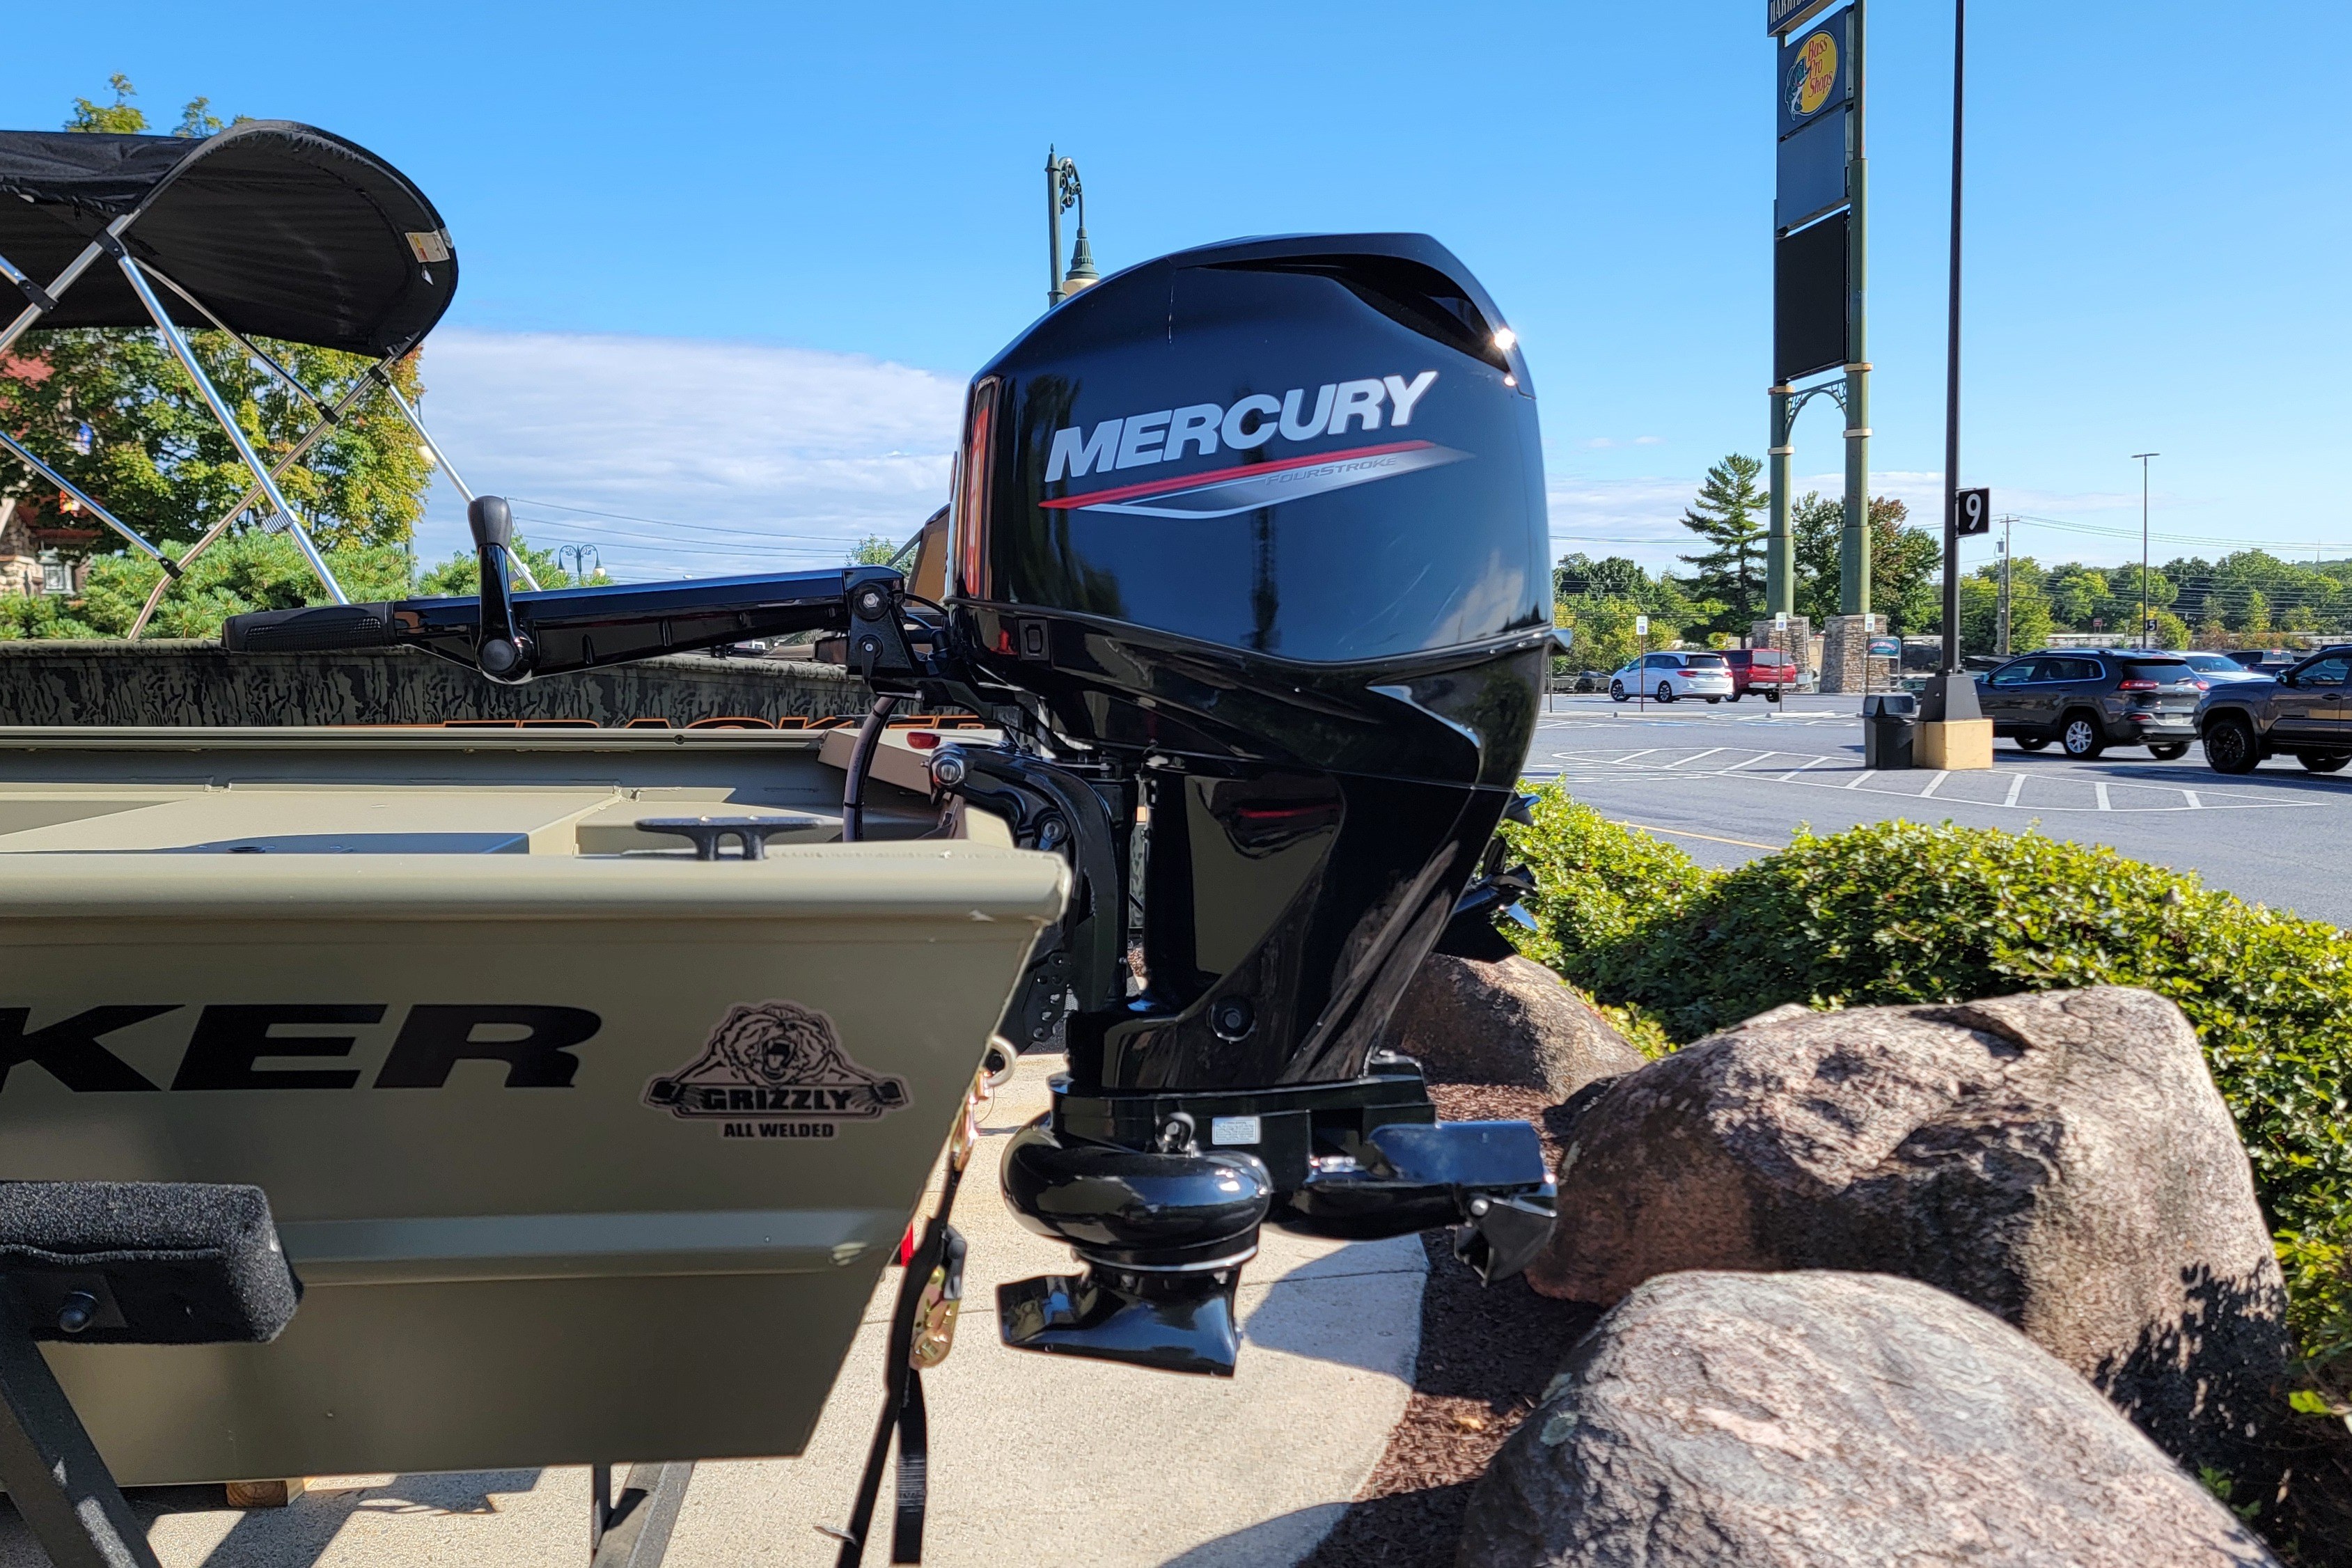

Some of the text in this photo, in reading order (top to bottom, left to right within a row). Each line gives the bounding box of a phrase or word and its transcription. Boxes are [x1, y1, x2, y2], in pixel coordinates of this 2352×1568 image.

[1808, 37, 1828, 62] Bass
[1810, 59, 1823, 79] Pro
[1808, 71, 1833, 97] Shops
[1044, 370, 1438, 483] MERCURY
[1265, 456, 1397, 485] FOURSTROKE
[1966, 493, 1982, 531] 9
[0, 1004, 602, 1092] KER
[703, 1088, 853, 1111] GRIZZLY
[723, 1122, 834, 1138] ALL WELDED
